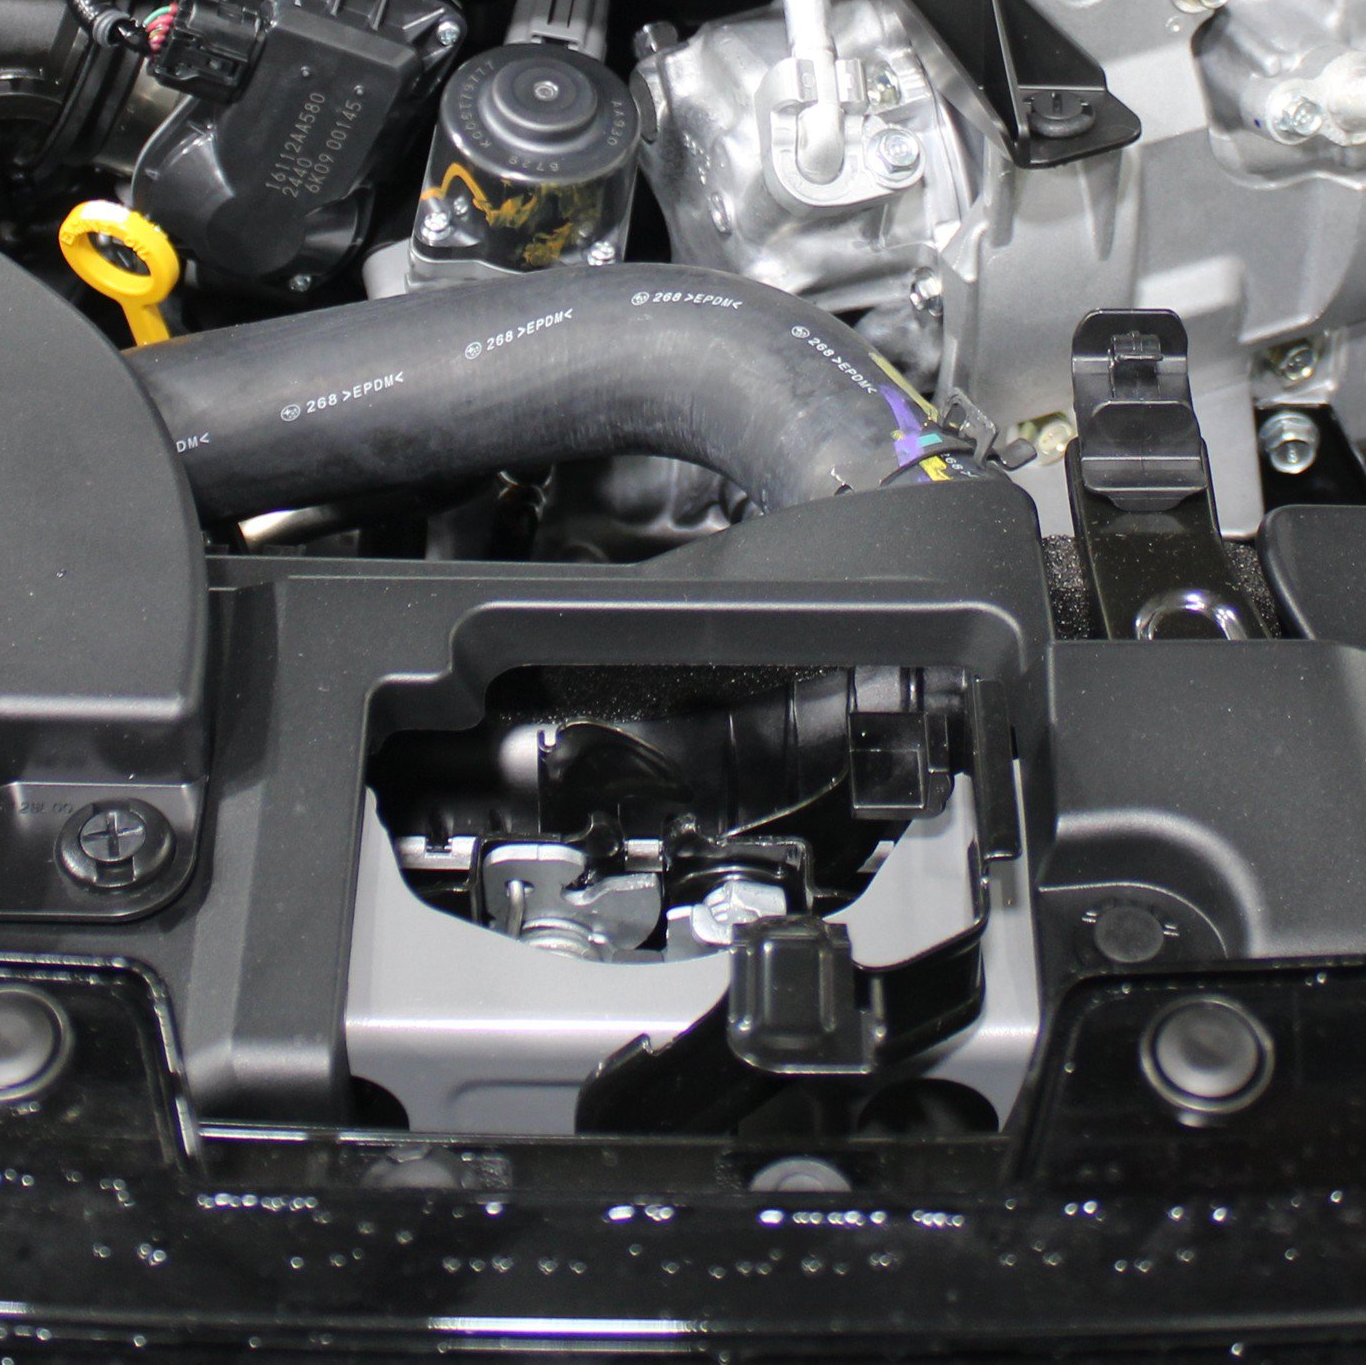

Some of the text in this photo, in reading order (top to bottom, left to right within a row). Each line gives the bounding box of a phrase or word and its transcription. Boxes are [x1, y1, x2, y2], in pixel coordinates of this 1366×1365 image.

[265, 92, 325, 190] 16112AA580
[305, 100, 362, 194] 6K09 00145
[282, 157, 312, 198] 2440
[509, 156, 560, 172] 6729
[652, 292, 743, 310] 268 >EPDM<
[486, 308, 573, 351] 268 >EPDM<
[808, 337, 877, 394] 268 >EPDM<
[305, 371, 404, 414] 268 >EPDM<
